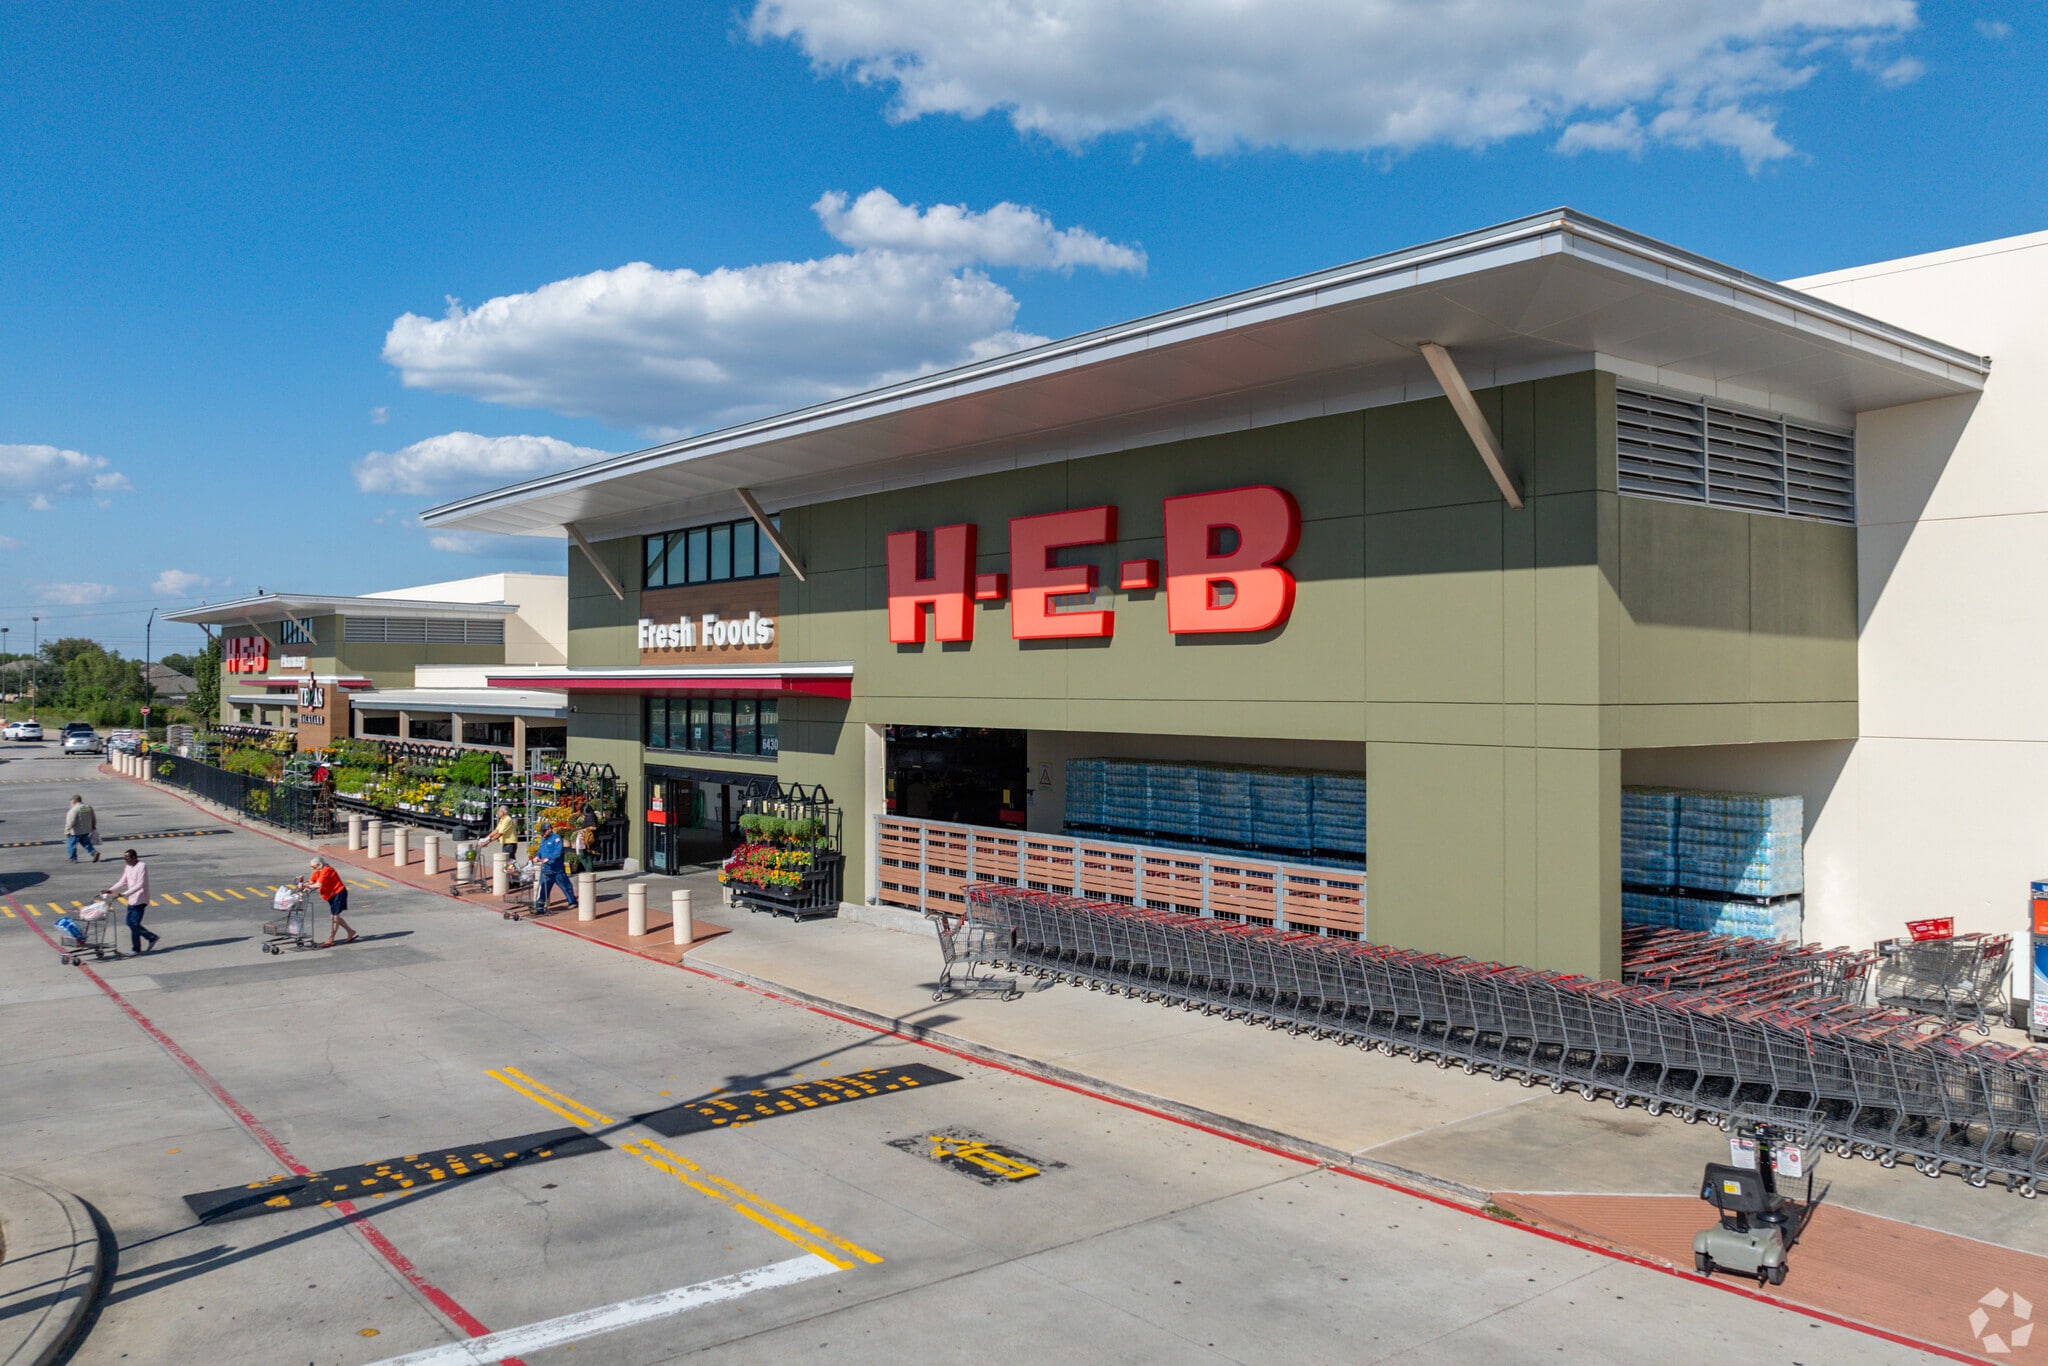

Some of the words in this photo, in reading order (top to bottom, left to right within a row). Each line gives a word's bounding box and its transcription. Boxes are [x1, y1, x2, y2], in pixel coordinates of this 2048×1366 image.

[886, 485, 1301, 644] H-E-B
[638, 615, 697, 648] Fresh
[702, 610, 775, 647] Foods
[762, 738, 778, 750] 6430
